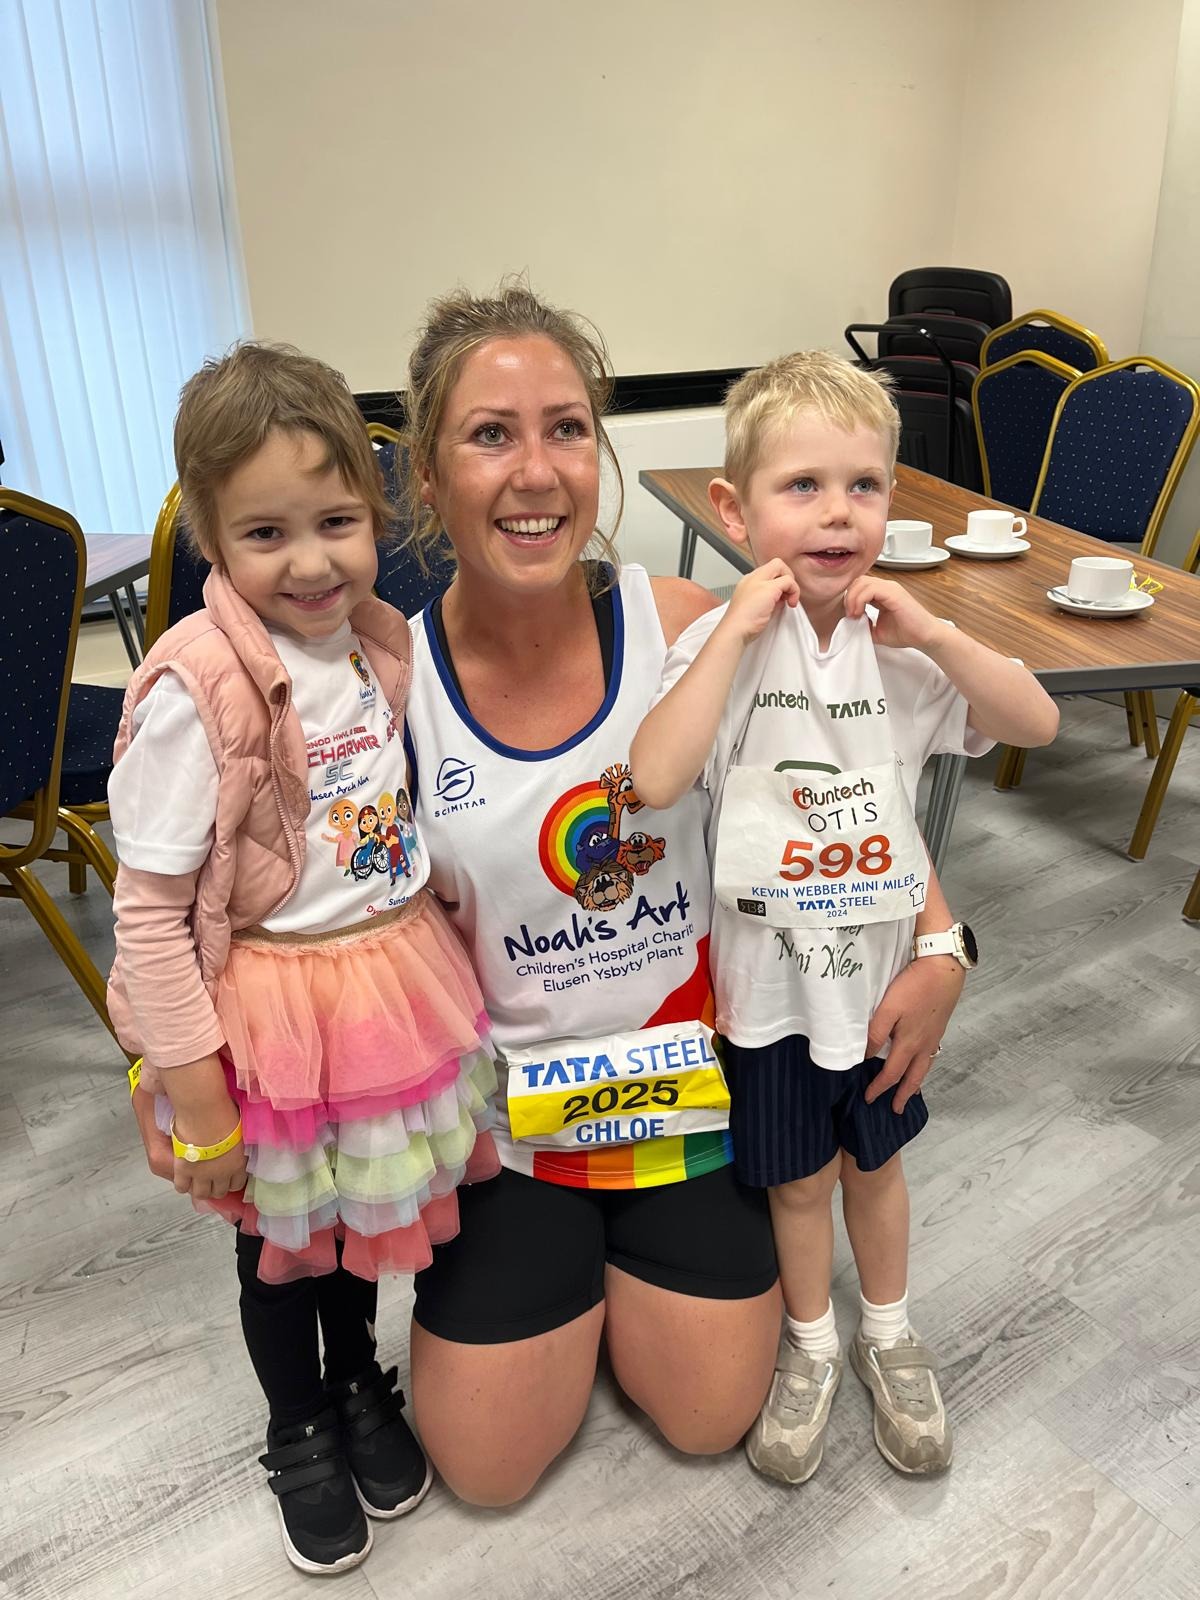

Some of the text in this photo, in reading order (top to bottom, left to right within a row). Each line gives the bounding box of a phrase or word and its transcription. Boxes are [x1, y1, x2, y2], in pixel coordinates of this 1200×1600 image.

[827, 700, 872, 719] TATA
[801, 777, 875, 807] Runtech
[434, 798, 486, 818] SCIMITAR
[807, 801, 878, 833] OTIS
[778, 834, 893, 882] 598
[751, 873, 916, 899] KEVIN WEBBER MINI MILER
[796, 895, 877, 911] TATA STEEL
[826, 909, 848, 918] 2024
[503, 880, 691, 962] Noah's Ark
[516, 957, 586, 978] Children's
[588, 936, 649, 965] Hospital
[543, 945, 685, 993] Elusen Ysbyty Plant
[521, 1036, 717, 1088] TATA STEEL
[562, 1079, 679, 1125] 2025
[575, 1117, 665, 1144] CHLOE
